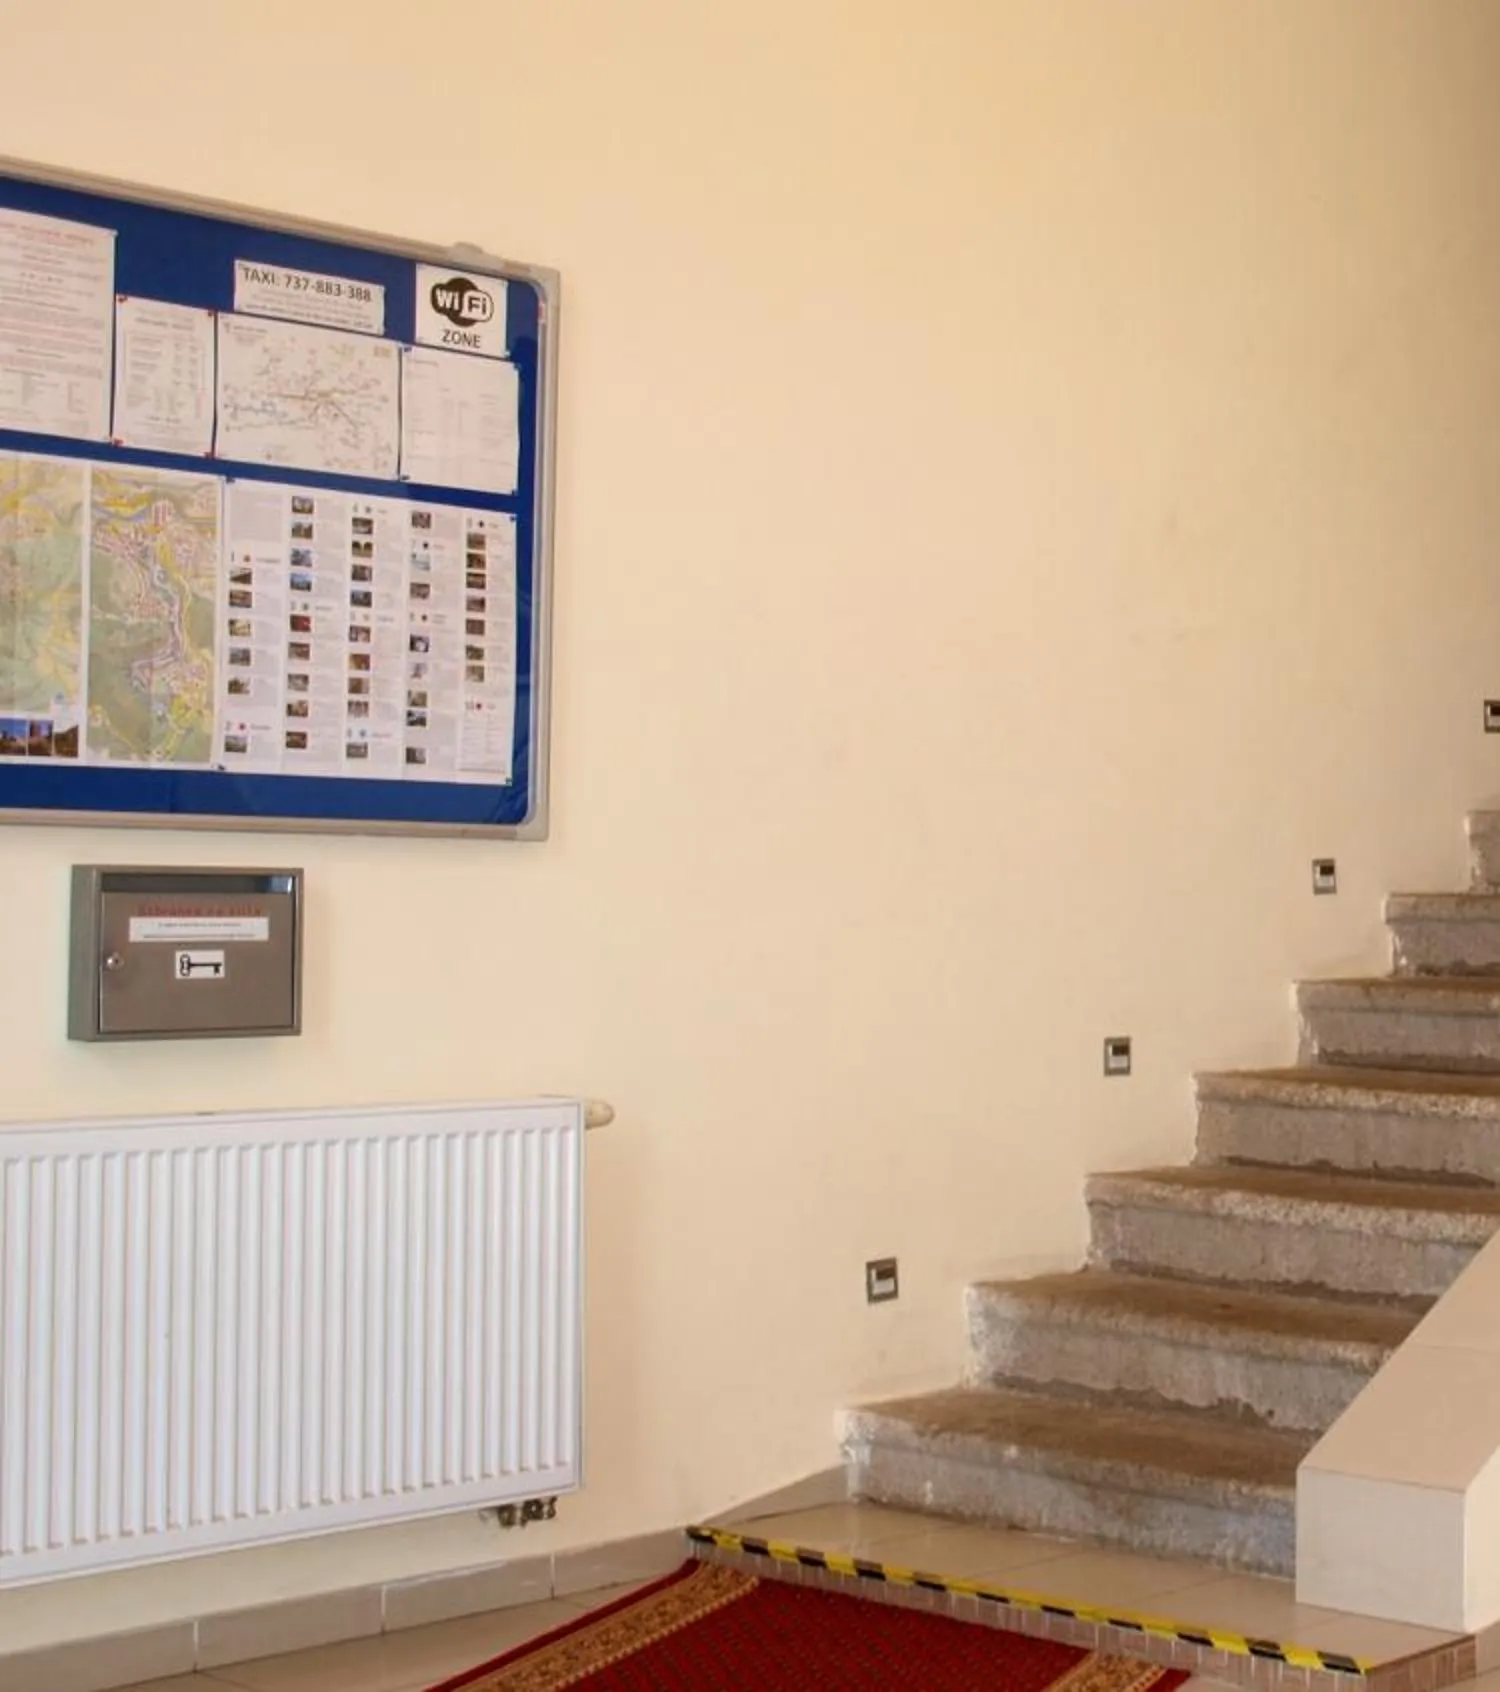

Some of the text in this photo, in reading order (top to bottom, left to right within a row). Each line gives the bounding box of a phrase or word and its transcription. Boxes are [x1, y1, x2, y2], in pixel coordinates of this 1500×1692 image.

[242, 267, 372, 302] TAXI: 737-883-388
[441, 328, 482, 349] ZONE
